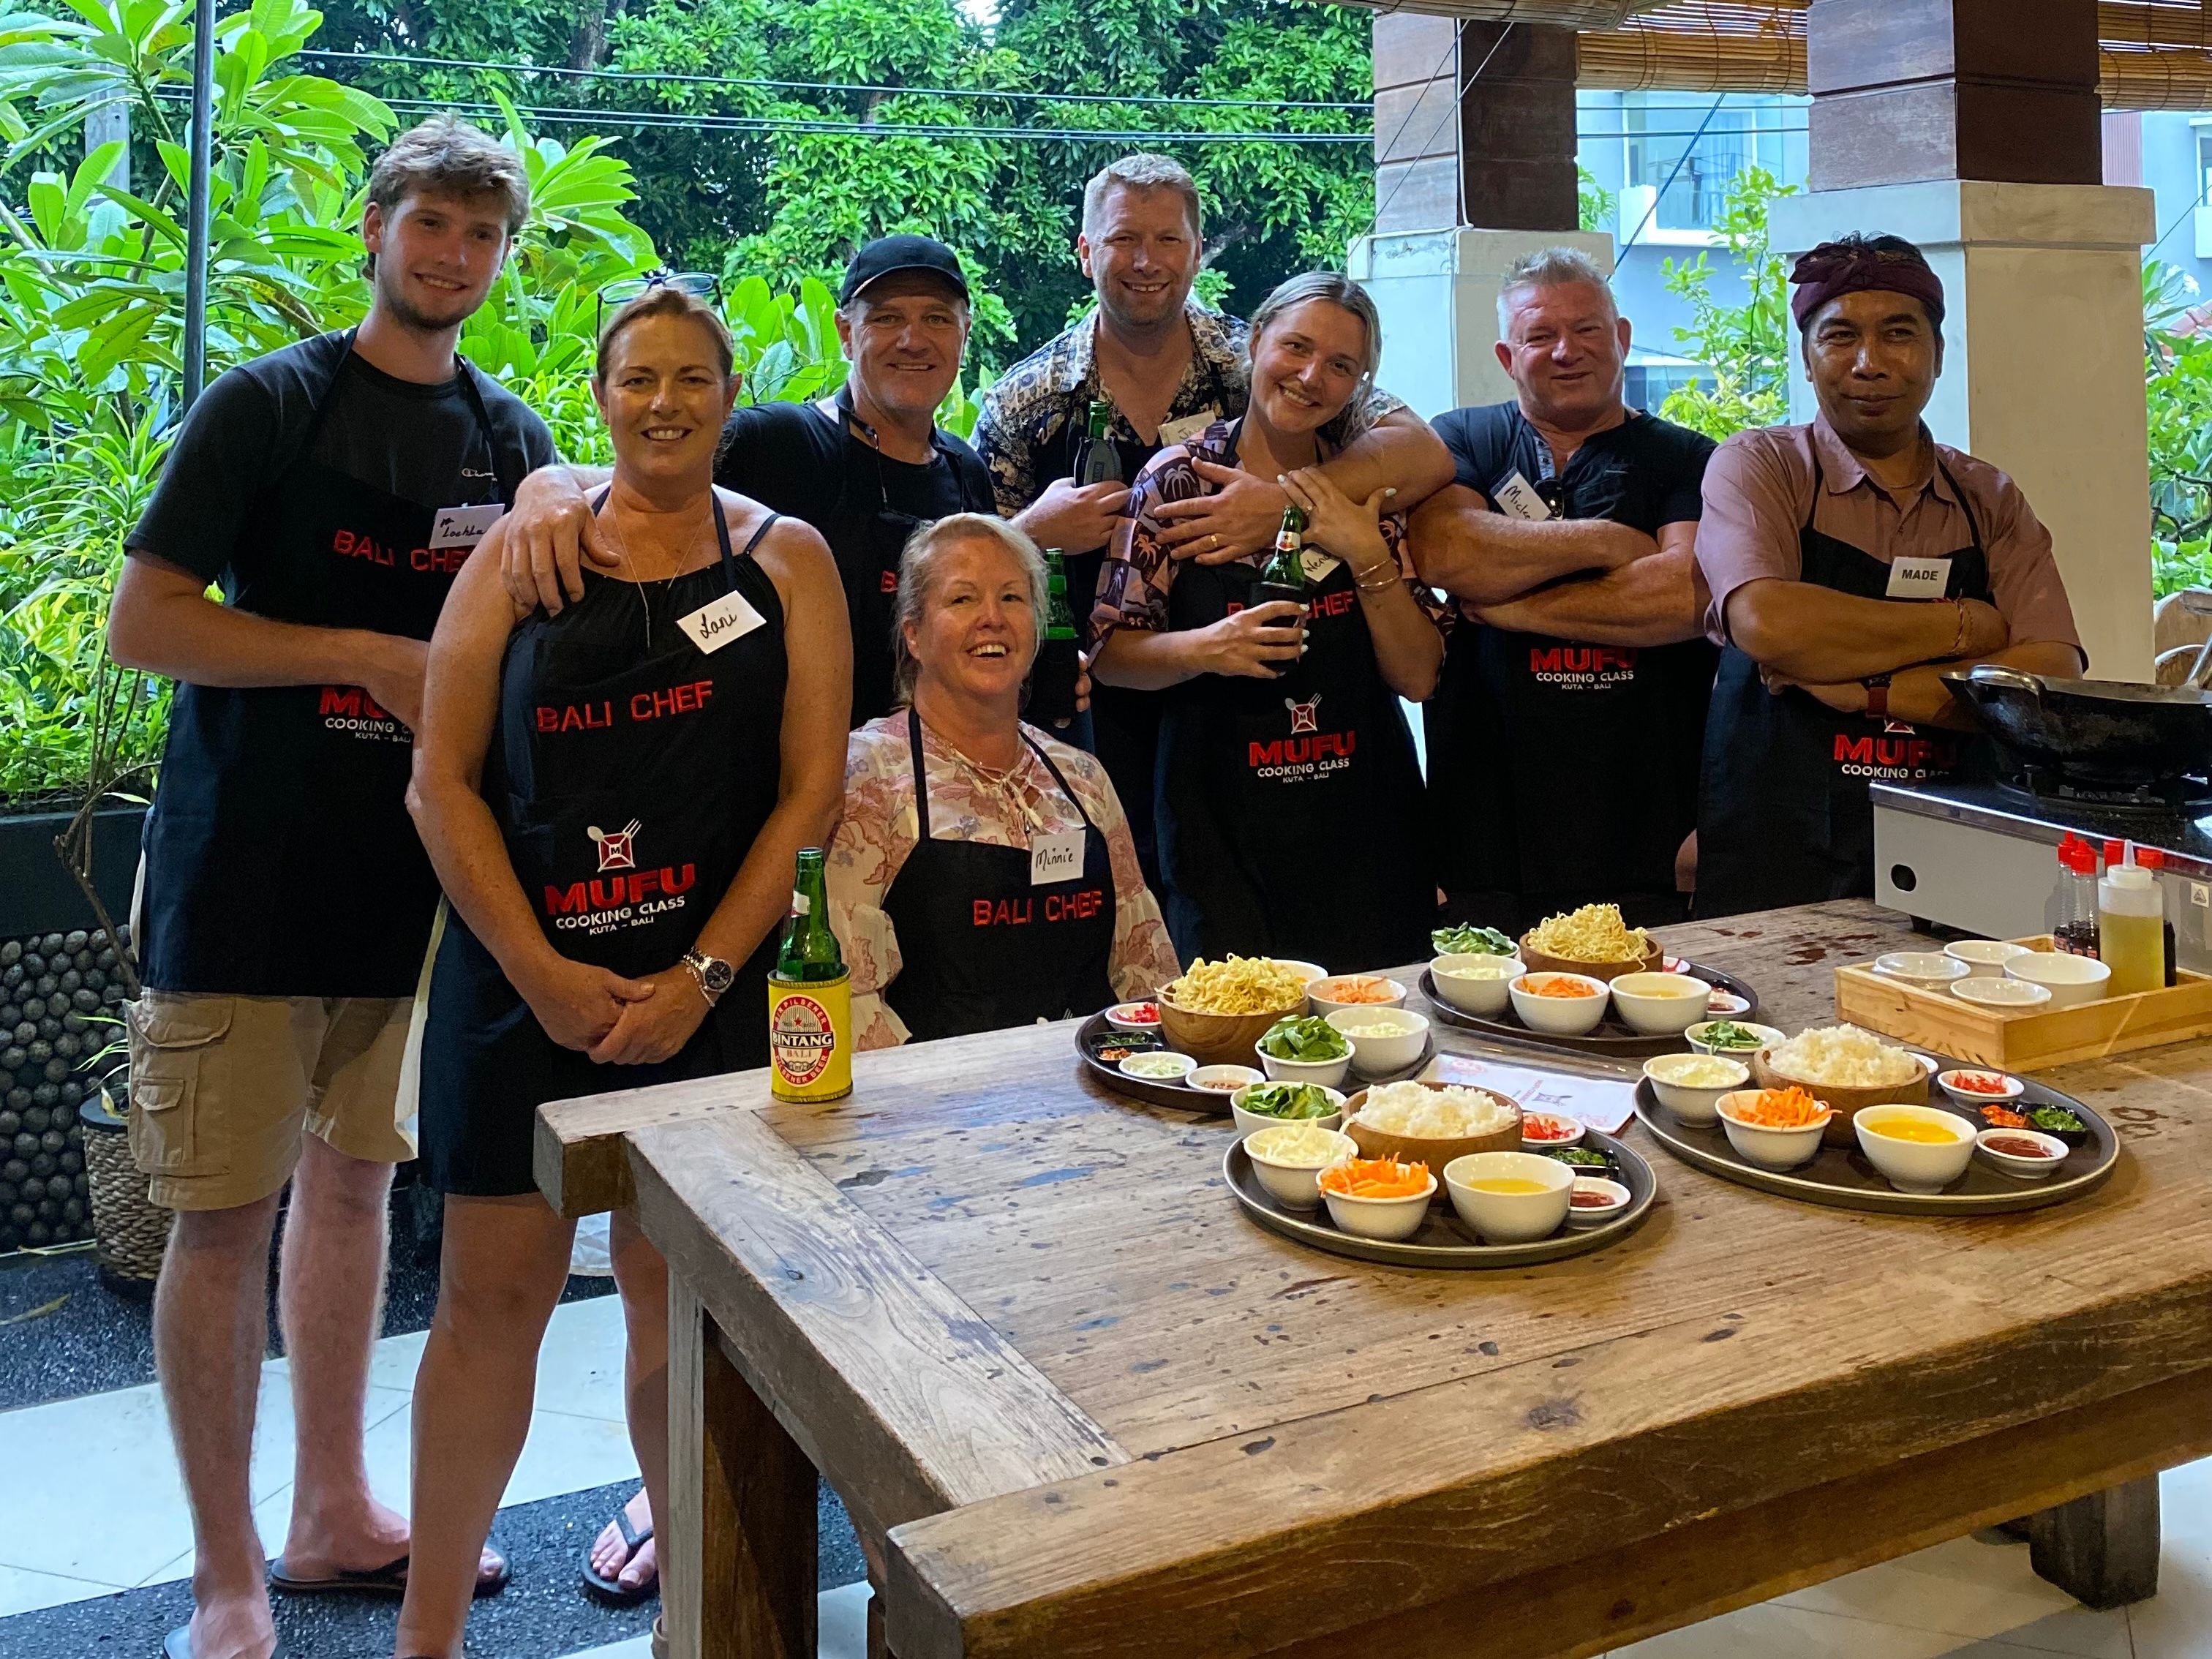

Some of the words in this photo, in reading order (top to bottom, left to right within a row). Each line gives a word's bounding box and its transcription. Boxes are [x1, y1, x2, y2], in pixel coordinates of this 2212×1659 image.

[333, 529, 395, 567] BALI
[410, 549, 470, 573] CHE
[1901, 568, 1938, 580] MADE
[1306, 590, 1353, 619] HEF
[1530, 648, 1639, 672] MUFU
[1536, 672, 1595, 682] COOKING
[1600, 670, 1634, 681] CLASS
[536, 701, 612, 732] BALI
[631, 680, 713, 721] CHEF
[325, 718, 395, 733] COOKING
[354, 731, 380, 740] KUTA
[1249, 731, 1356, 767] MUFU
[1257, 763, 1314, 777] COOKING
[1319, 758, 1350, 770] CLASS
[1314, 772, 1330, 780] BALI
[1841, 764, 1908, 778] COOKING
[1035, 847, 1074, 872] Minnie
[543, 862, 695, 915] MUFU
[556, 907, 632, 930] COOKING
[639, 895, 685, 915] CLASS
[973, 897, 1033, 926] BALI
[1045, 890, 1102, 922] CHEF
[589, 923, 617, 936] KUTA
[631, 916, 654, 927] BALI
[783, 998, 827, 1025] PILSENER
[772, 1032, 832, 1047] BINTANG
